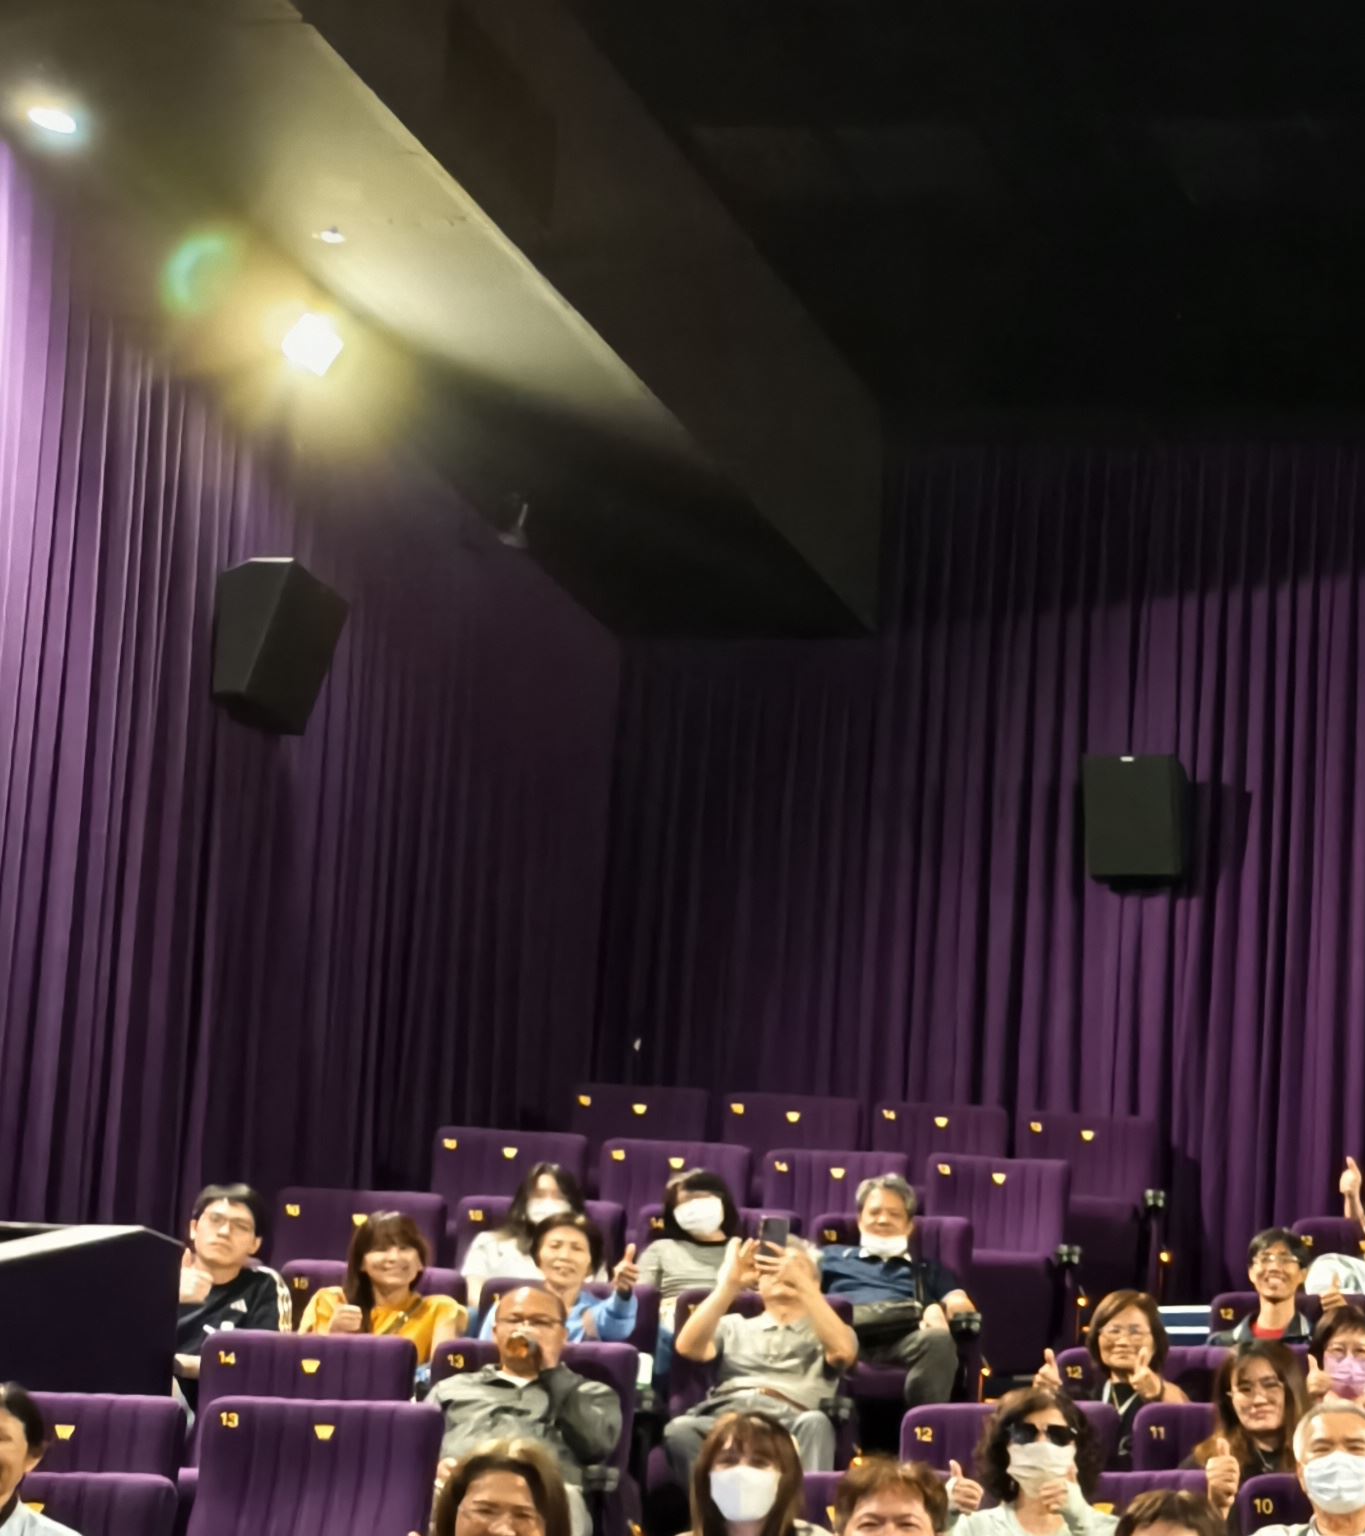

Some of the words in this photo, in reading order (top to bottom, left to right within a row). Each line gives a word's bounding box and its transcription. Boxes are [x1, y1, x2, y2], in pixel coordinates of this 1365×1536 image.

[1220, 1308, 1234, 1320] 12
[219, 1351, 236, 1365] 14
[447, 1354, 464, 1369] 13
[1066, 1366, 1083, 1379] 12
[220, 1412, 239, 1428] 13
[914, 1427, 933, 1442] 12
[1149, 1425, 1165, 1440] 11
[1253, 1498, 1274, 1515] 10
